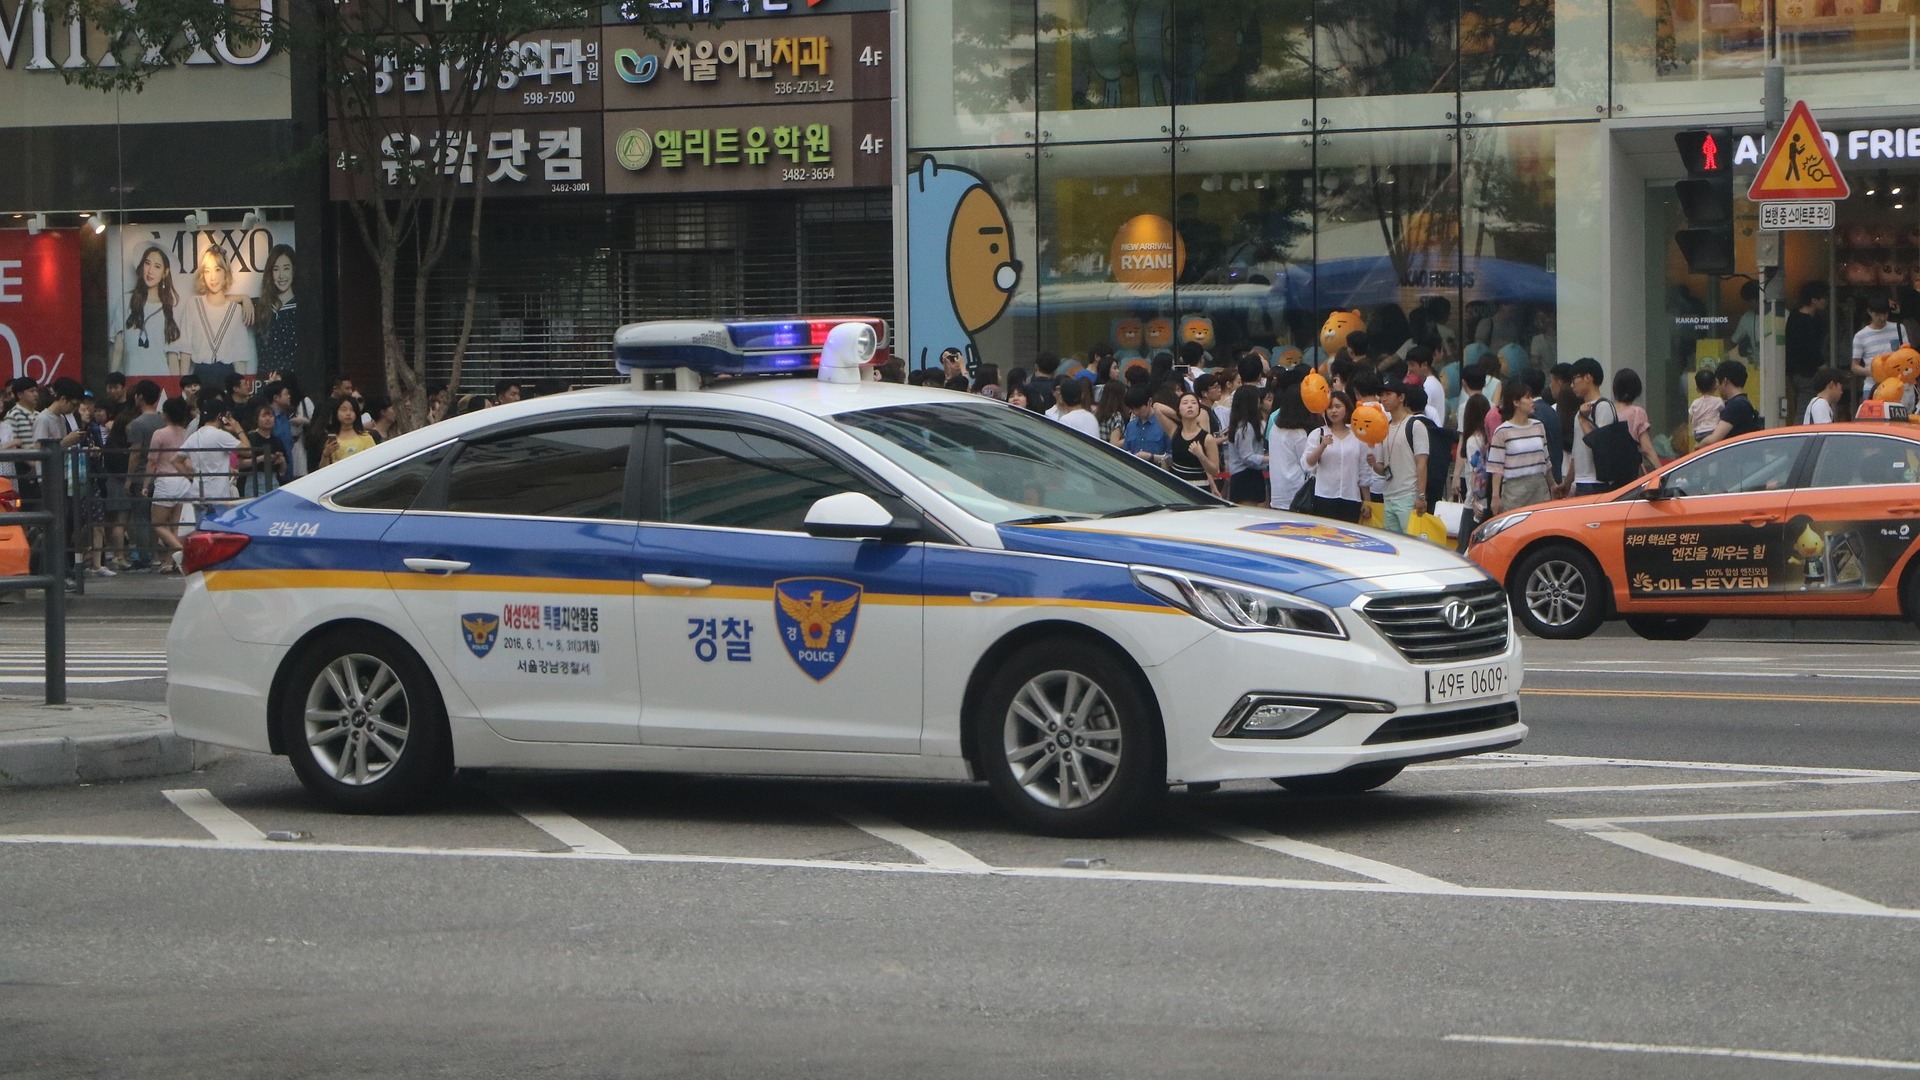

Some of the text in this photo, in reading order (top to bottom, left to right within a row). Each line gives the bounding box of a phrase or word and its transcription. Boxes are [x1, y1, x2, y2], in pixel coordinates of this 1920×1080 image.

[664, 36, 830, 81] 서울이건치과
[859, 46, 882, 66] 4F
[775, 80, 834, 94] 536-2751~2
[523, 91, 575, 104] 598-7500
[654, 123, 831, 168] 엘리트유학원
[860, 133, 884, 154] 4F
[381, 127, 582, 185] 유학닷컴
[782, 167, 835, 181] 3482-3654
[551, 183, 590, 192] 3482-3001
[1788, 206, 1815, 225] 스마트폰
[1817, 206, 1830, 225] 주의
[1139, 242, 1172, 250] ARRIVAL
[1121, 254, 1172, 270] RYAN!
[1700, 316, 1728, 324] FRIENDS
[1890, 407, 1907, 418] TAXI
[268, 522, 320, 537] 강남 04
[1626, 532, 1699, 547] 차의 핵심은 엔진
[1672, 544, 1766, 562] 엔진을 깨우는 힘
[1705, 569, 1723, 577] 100%
[1740, 567, 1768, 576] 엔진오일
[1642, 576, 1770, 592] S-OIL SEVEN
[503, 604, 540, 630] 여성안전
[687, 616, 754, 662] 경찰
[787, 627, 845, 643] 경 찰
[503, 637, 524, 650] 2016.
[798, 650, 835, 663] POLICE
[517, 659, 591, 675] 서울강남경찰서
[1438, 667, 1503, 698] 49두 0609
